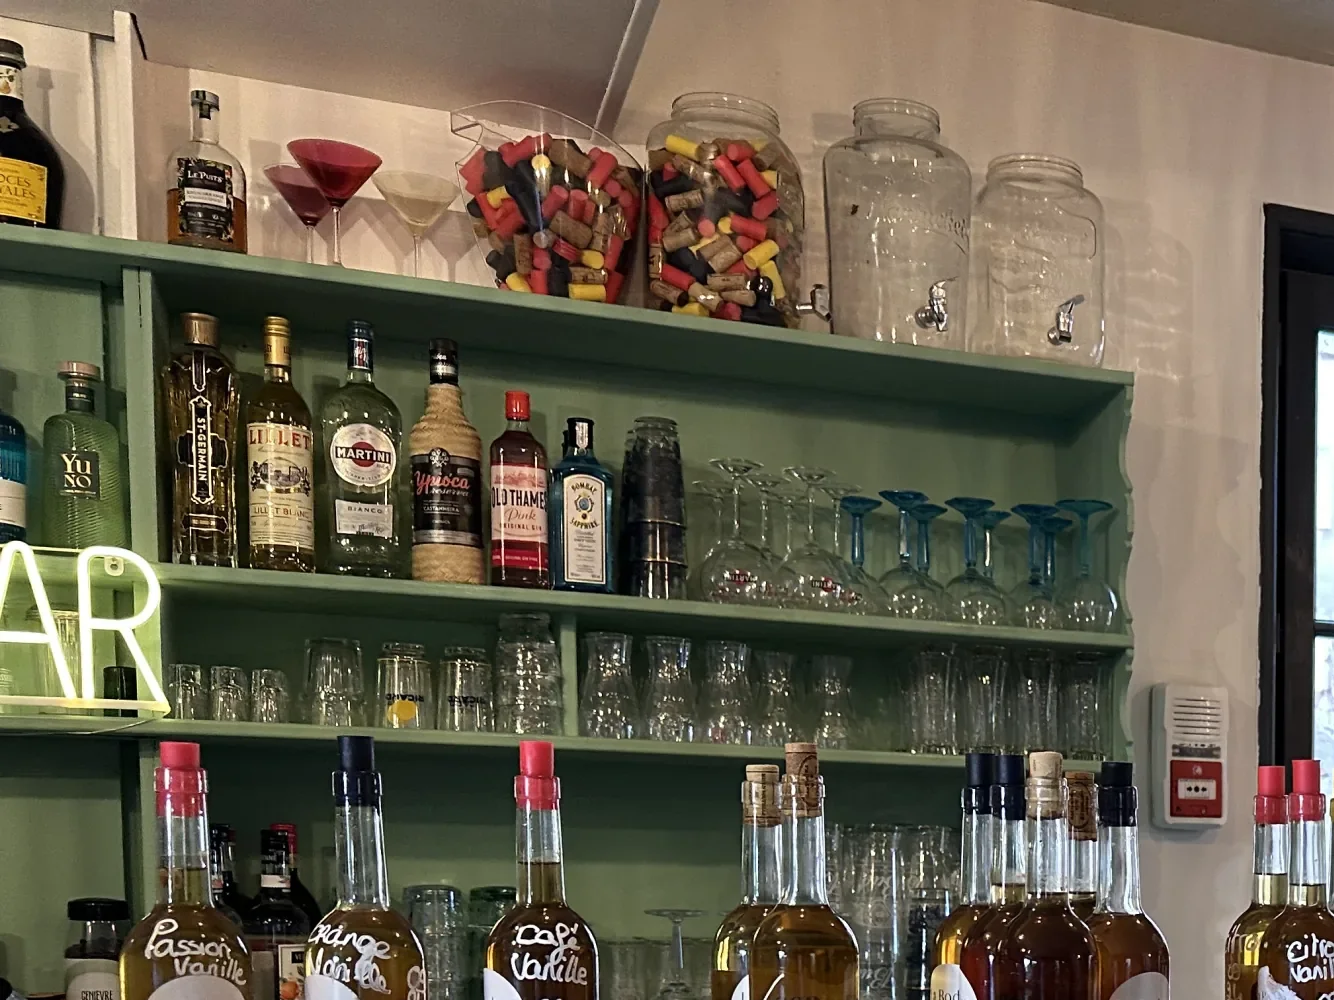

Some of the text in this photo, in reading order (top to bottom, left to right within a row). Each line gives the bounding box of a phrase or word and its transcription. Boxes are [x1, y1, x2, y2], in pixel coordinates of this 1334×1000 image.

[249, 429, 312, 451] LILLET
[197, 417, 208, 481] ST-GERMAIN
[336, 448, 391, 463] MARTINI
[63, 474, 92, 489] NO
[571, 481, 598, 495] BOMBAY
[492, 486, 548, 513] OLD THAMES
[254, 506, 280, 516] LILLT
[347, 506, 383, 515] BIANCO
[504, 508, 537, 521] Pink
[569, 516, 600, 530] SAPPHIRE
[144, 918, 232, 960] Passion
